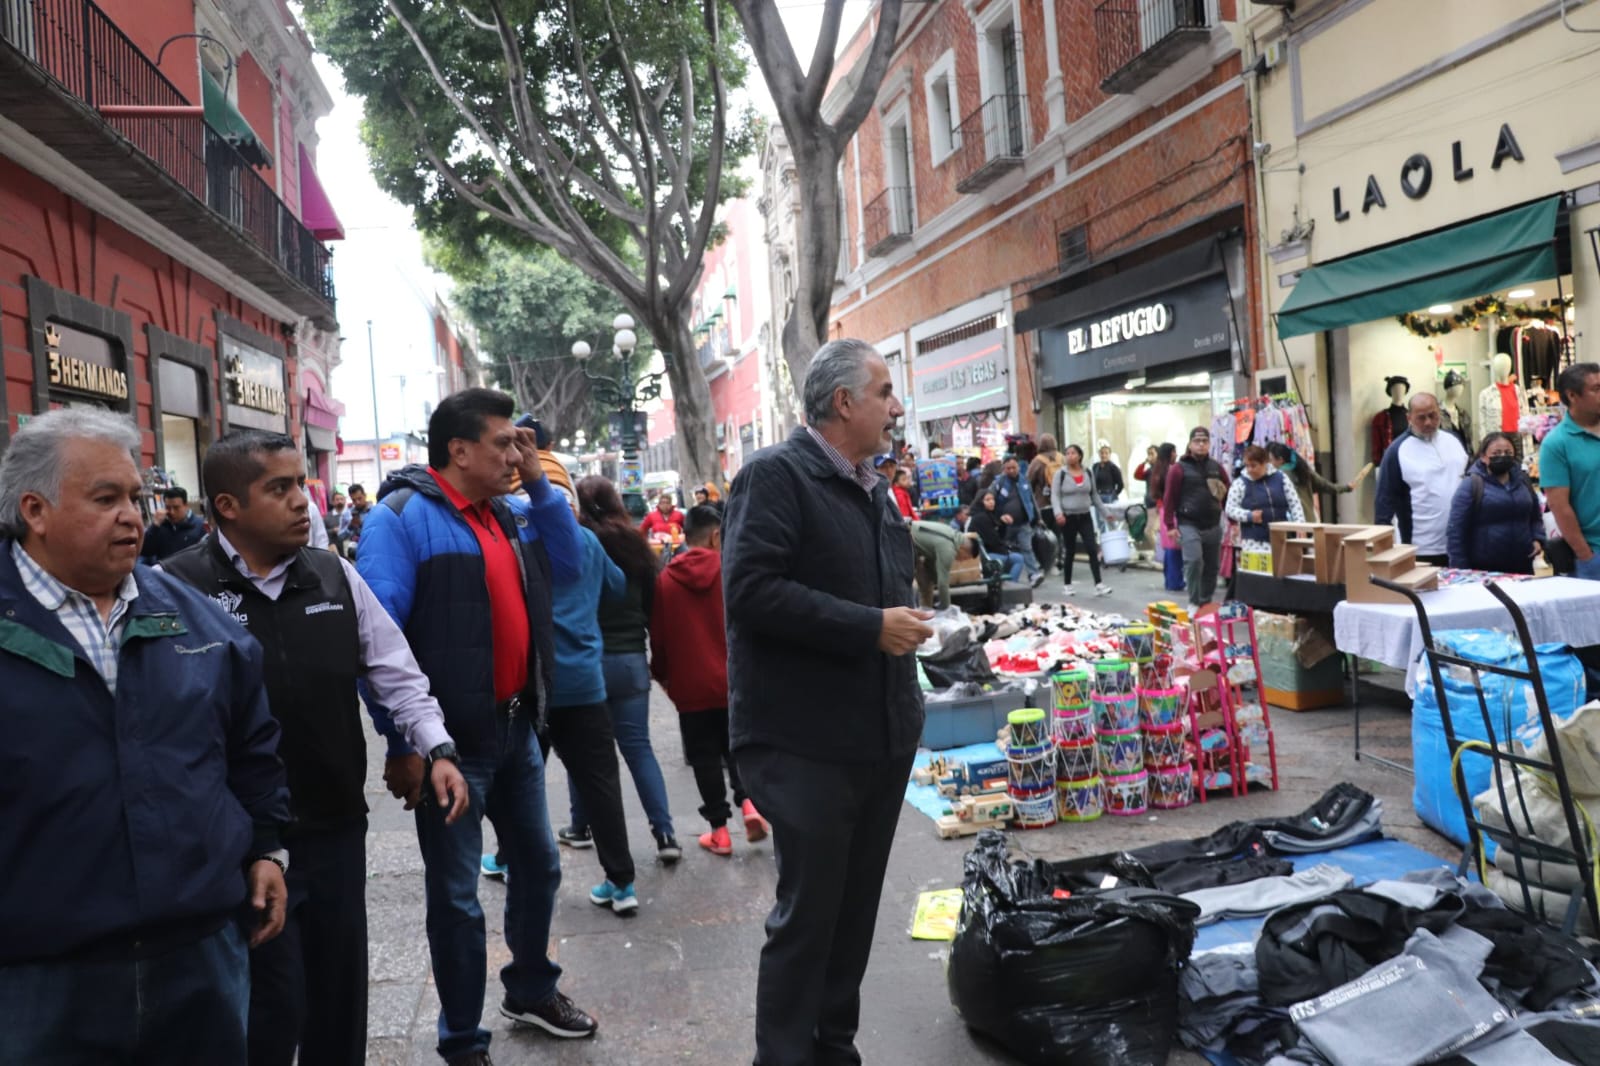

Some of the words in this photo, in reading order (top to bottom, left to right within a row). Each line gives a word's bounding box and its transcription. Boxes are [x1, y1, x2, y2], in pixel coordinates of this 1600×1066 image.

[1068, 328, 1086, 355] EL
[1090, 303, 1168, 349] REFUGIO
[49, 352, 61, 383] 3
[61, 355, 128, 399] HERMANOS
[237, 377, 244, 405] 3
[244, 378, 286, 416] HERMANOS
